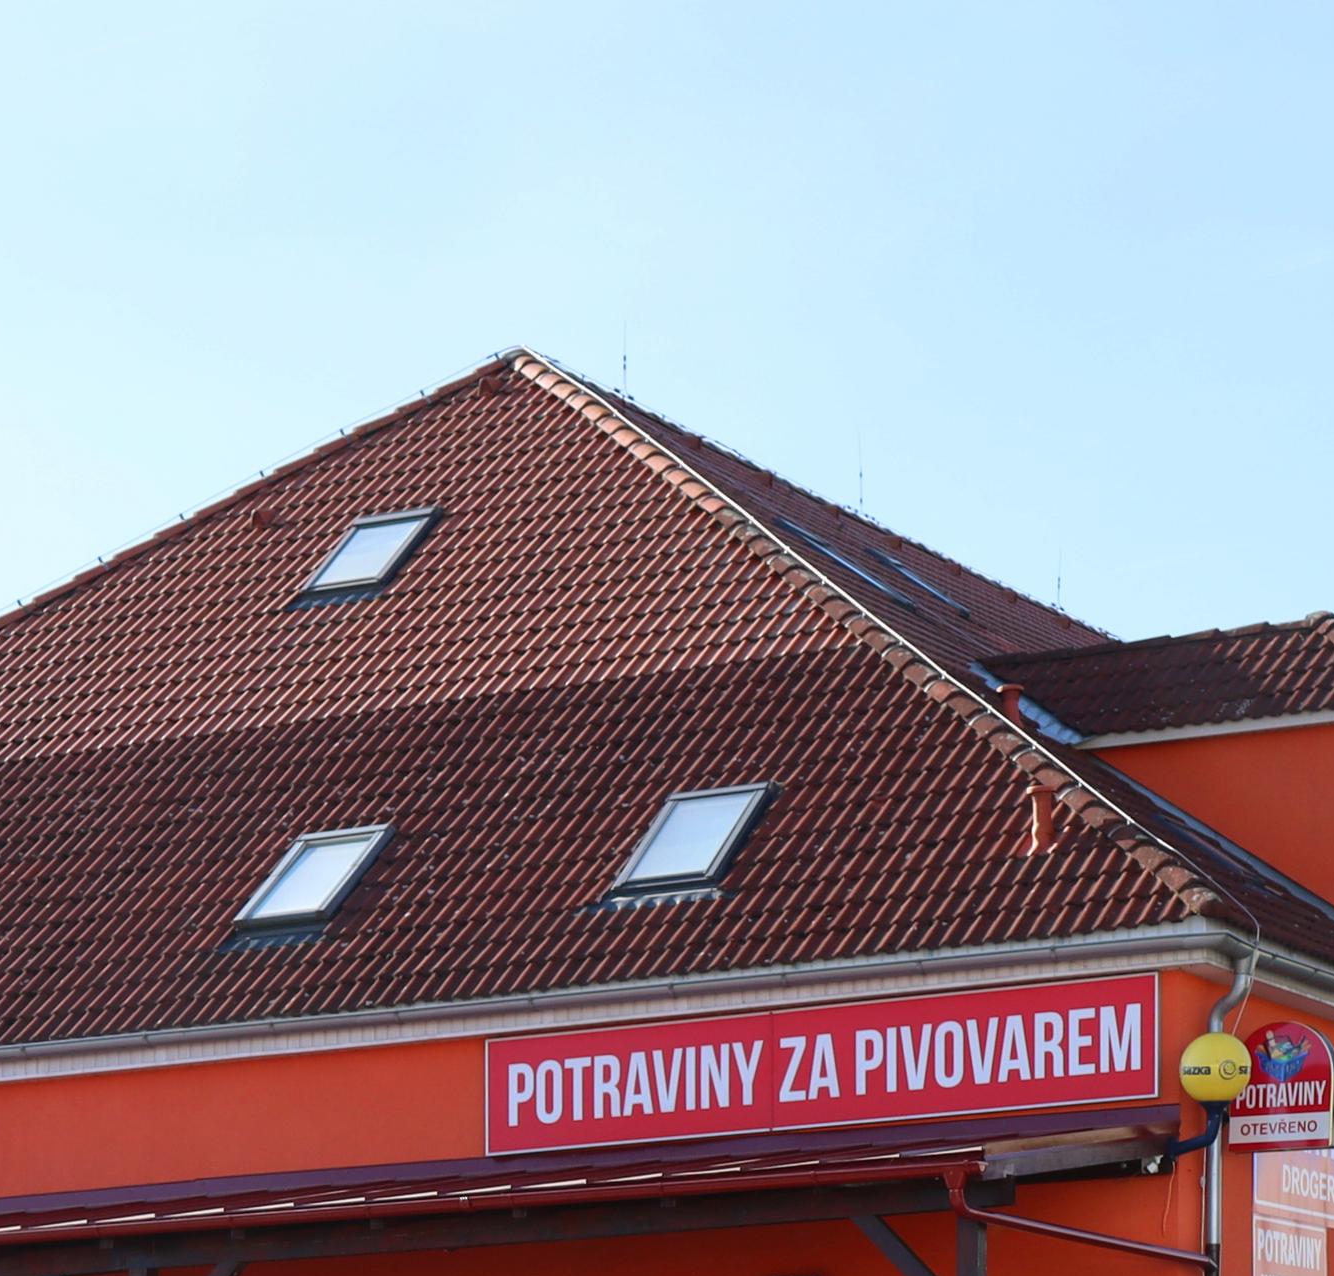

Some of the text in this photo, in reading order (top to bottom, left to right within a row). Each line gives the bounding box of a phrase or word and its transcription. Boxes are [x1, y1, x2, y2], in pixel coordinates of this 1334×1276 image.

[507, 1003, 1142, 1128] POTRAVINY ZA PIVOVAREM
[1235, 1080, 1327, 1110] POTRAVINY
[1240, 1119, 1318, 1136] OTEVŘENO
[1257, 1228, 1323, 1271] POTRAVINY
